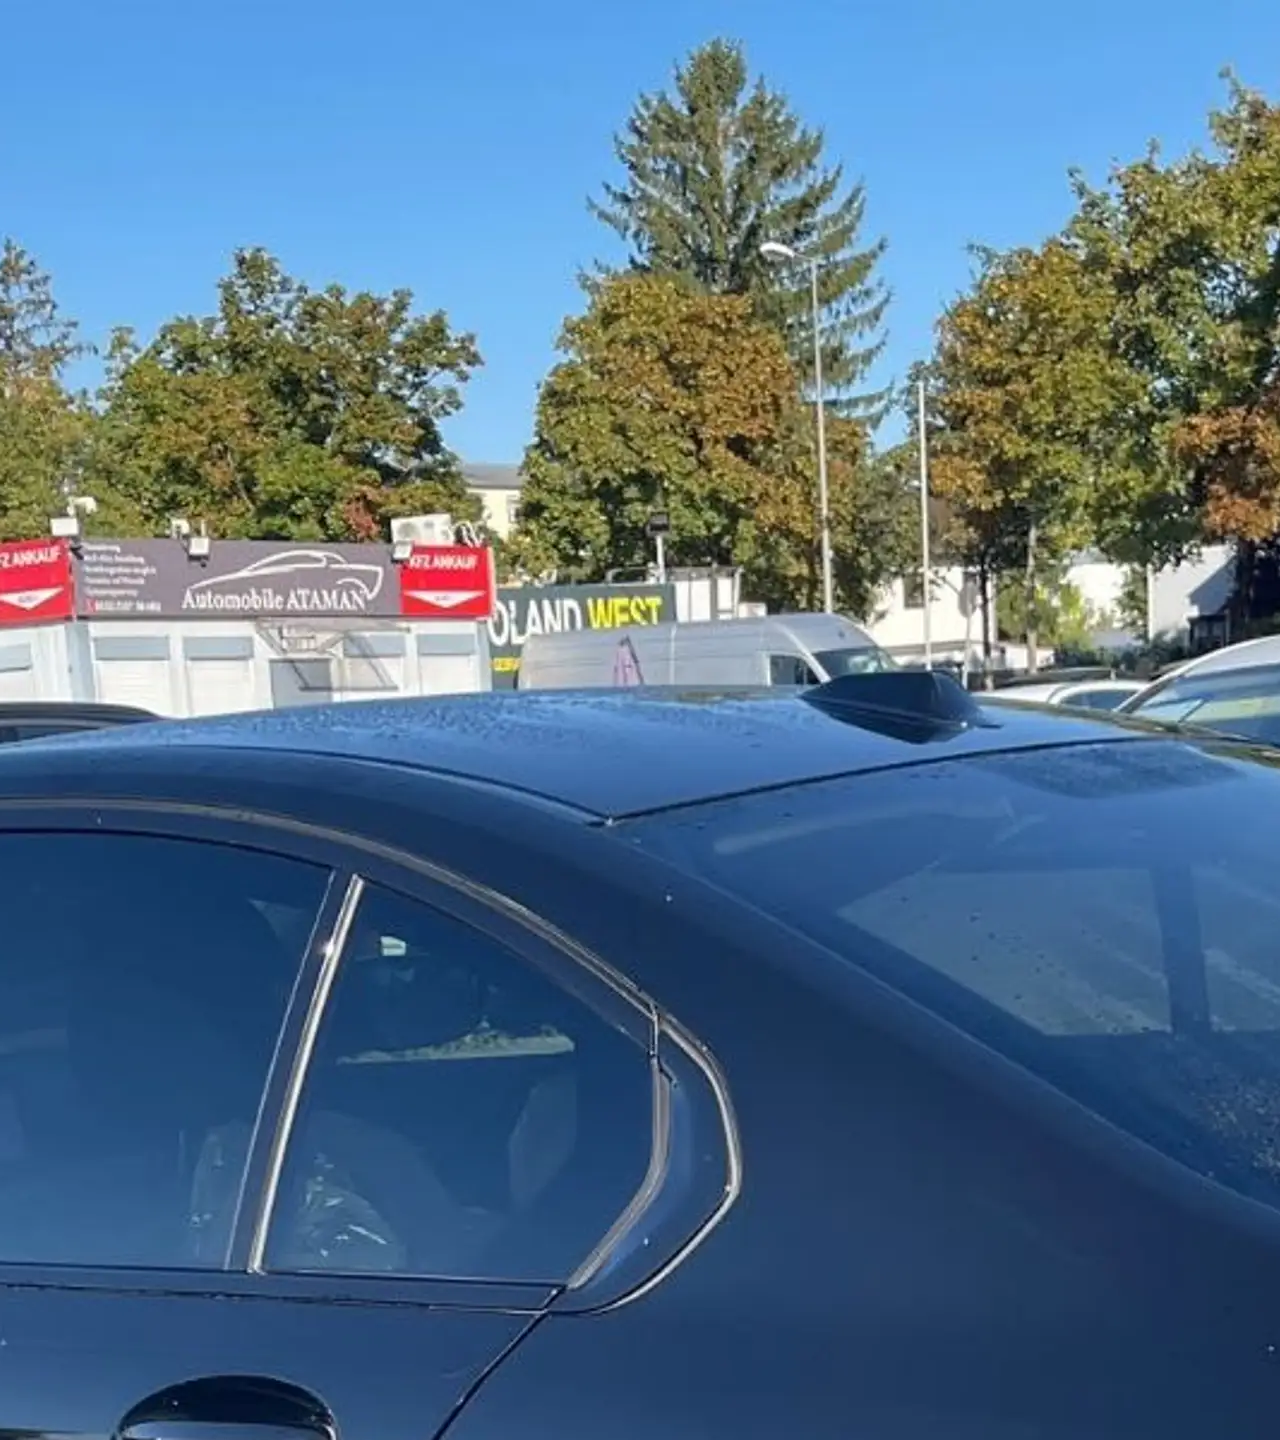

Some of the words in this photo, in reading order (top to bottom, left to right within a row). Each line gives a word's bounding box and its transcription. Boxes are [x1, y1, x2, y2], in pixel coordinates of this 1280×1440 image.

[13, 547, 61, 566] ANKAUF
[433, 554, 478, 570] ANKAUF
[182, 588, 283, 611] Automobile
[287, 589, 367, 611] ATAMAN
[587, 596, 662, 630] WEST
